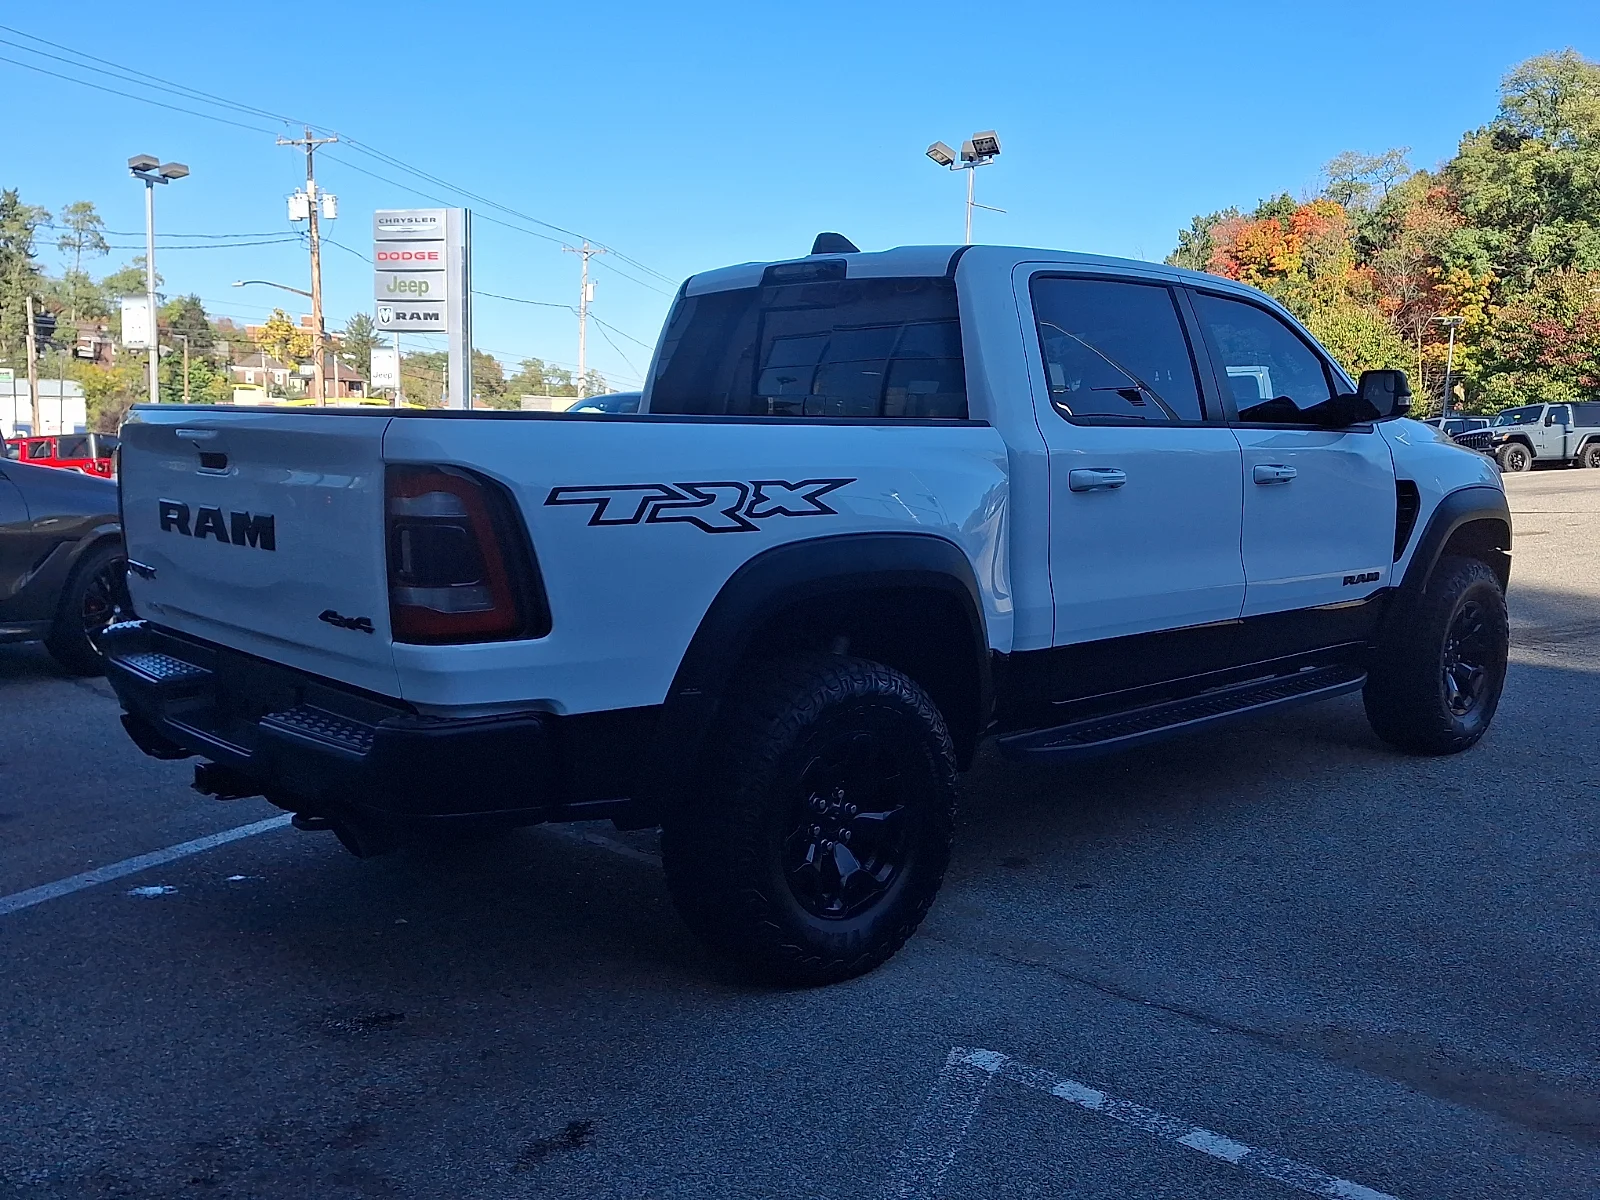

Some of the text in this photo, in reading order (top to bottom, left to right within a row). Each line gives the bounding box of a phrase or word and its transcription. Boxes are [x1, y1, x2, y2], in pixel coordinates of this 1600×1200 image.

[377, 251, 439, 261] DODGE
[386, 276, 430, 296] Jeep
[395, 312, 440, 321] RAM
[372, 371, 393, 380] Jeep
[543, 477, 858, 534] TRX
[158, 497, 277, 552] RAM
[1342, 571, 1380, 587] RAM
